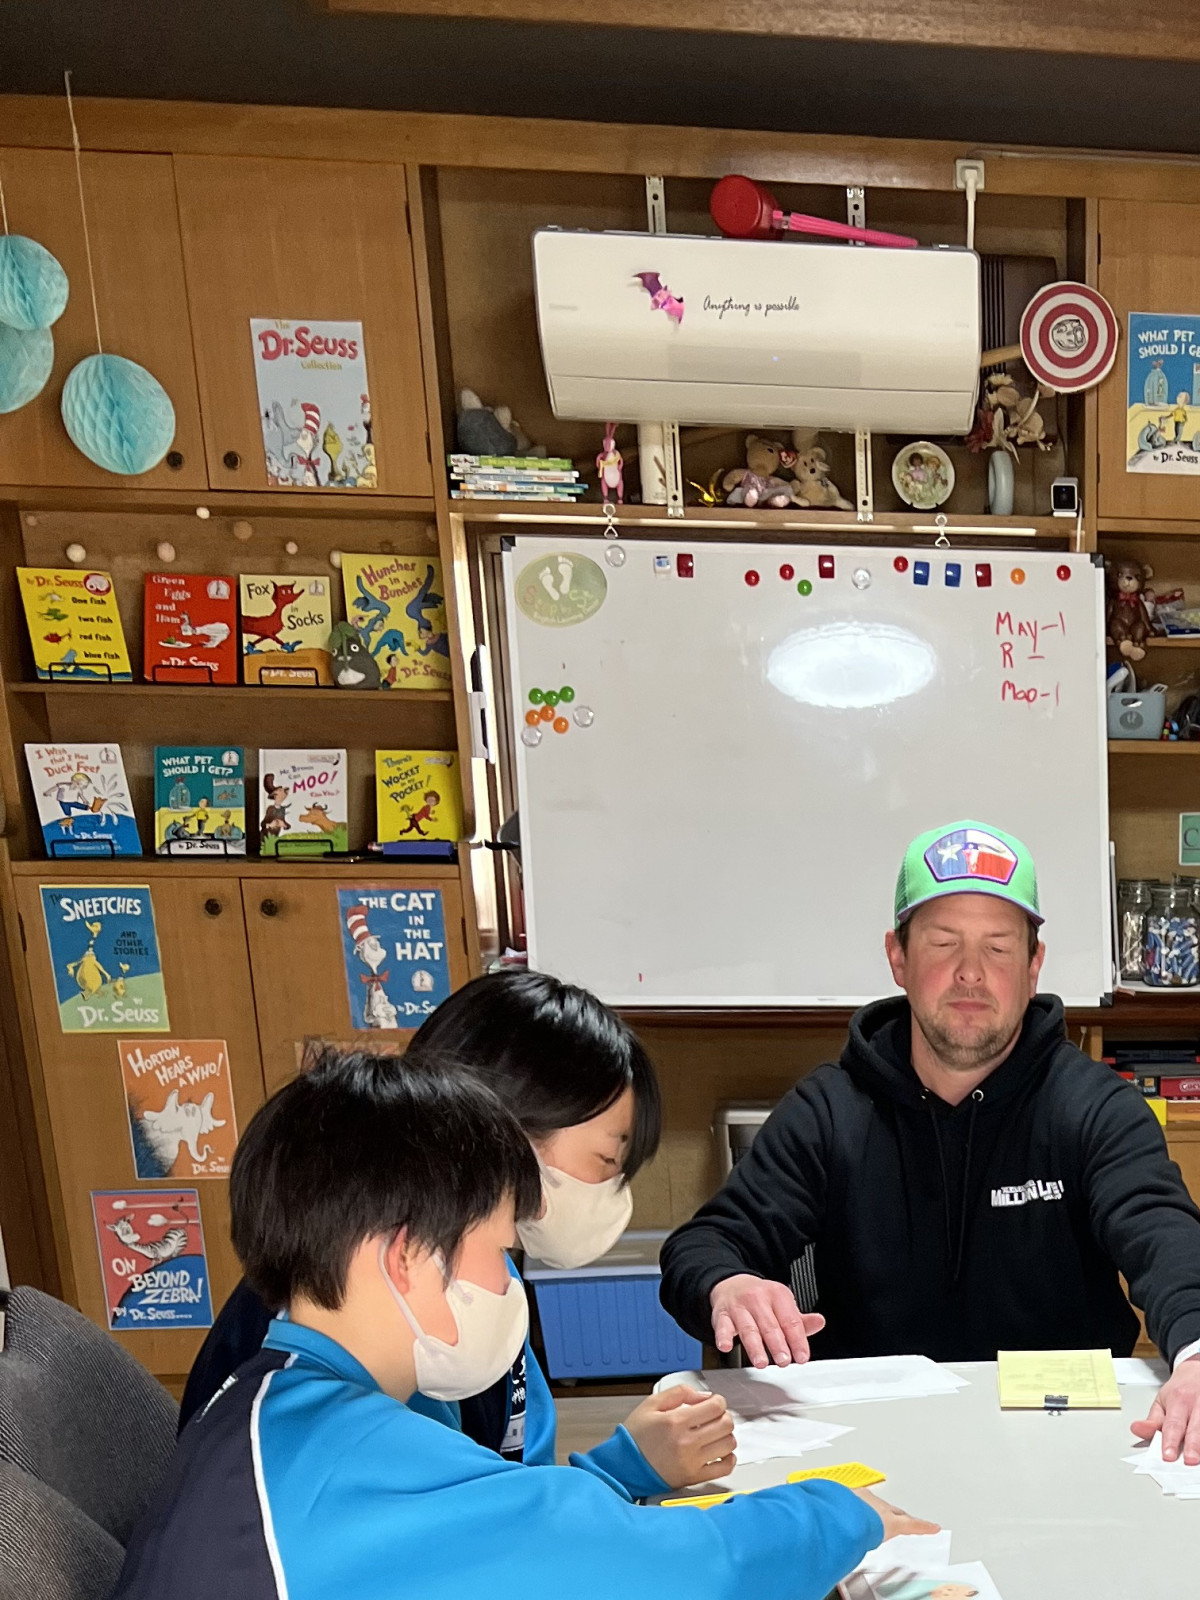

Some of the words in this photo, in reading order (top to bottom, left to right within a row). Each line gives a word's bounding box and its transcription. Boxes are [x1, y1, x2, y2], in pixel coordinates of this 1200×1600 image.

[703, 294, 750, 320] Anything
[765, 295, 800, 318] possible
[1138, 329, 1169, 343] WHAT
[1174, 330, 1195, 343] PET
[258, 329, 295, 361] Dr.
[295, 326, 359, 360] Seuss
[1138, 343, 1178, 359] SHOULD
[1161, 452, 1174, 464] Dr.
[1175, 451, 1198, 464] Seuss
[54, 575, 85, 589] Seuss
[152, 574, 186, 586] Green
[164, 587, 192, 601] Eggs
[246, 582, 271, 600] Fox
[378, 576, 425, 601] Bunches
[71, 596, 88, 605] One
[89, 596, 107, 606] fish
[155, 602, 177, 612] and
[291, 605, 300, 614] in
[78, 616, 95, 624] two
[97, 616, 114, 625] fish
[155, 614, 181, 624] Ham
[286, 610, 326, 631] Socks
[79, 633, 94, 641] red
[95, 633, 113, 642] fish
[84, 650, 102, 659] blue
[103, 651, 121, 660] fish
[400, 666, 421, 679] Dr.
[162, 755, 191, 767] WHAT
[194, 755, 214, 765] PET
[43, 763, 74, 777] Duck
[76, 761, 101, 774] Feet
[162, 764, 199, 778] SHOULD
[208, 766, 234, 777] GET?
[292, 769, 339, 794] MOO!
[381, 765, 421, 789] WOCKET
[185, 841, 198, 850] Dr.
[199, 840, 220, 850] Seuss
[60, 896, 142, 922] SNEETCHES
[358, 896, 388, 910] THE
[390, 892, 436, 912] CAT
[407, 915, 425, 926] IN
[120, 931, 138, 939] AND
[403, 928, 431, 940] THE
[115, 939, 144, 947] OTHER
[113, 947, 150, 956] STORIES
[395, 942, 444, 961] HAT
[77, 1005, 109, 1028] Dr.
[111, 1000, 160, 1024] Seuss
[404, 1001, 422, 1016] Dr.
[126, 1046, 181, 1079] HORTON
[154, 1055, 194, 1088] HEARS
[178, 1077, 188, 1089] A
[186, 1052, 224, 1086] WHO!
[111, 1257, 136, 1277] ON
[127, 1269, 191, 1293] BEYOND
[138, 1277, 204, 1305] ZEBRA!
[129, 1307, 147, 1321] Dr.
